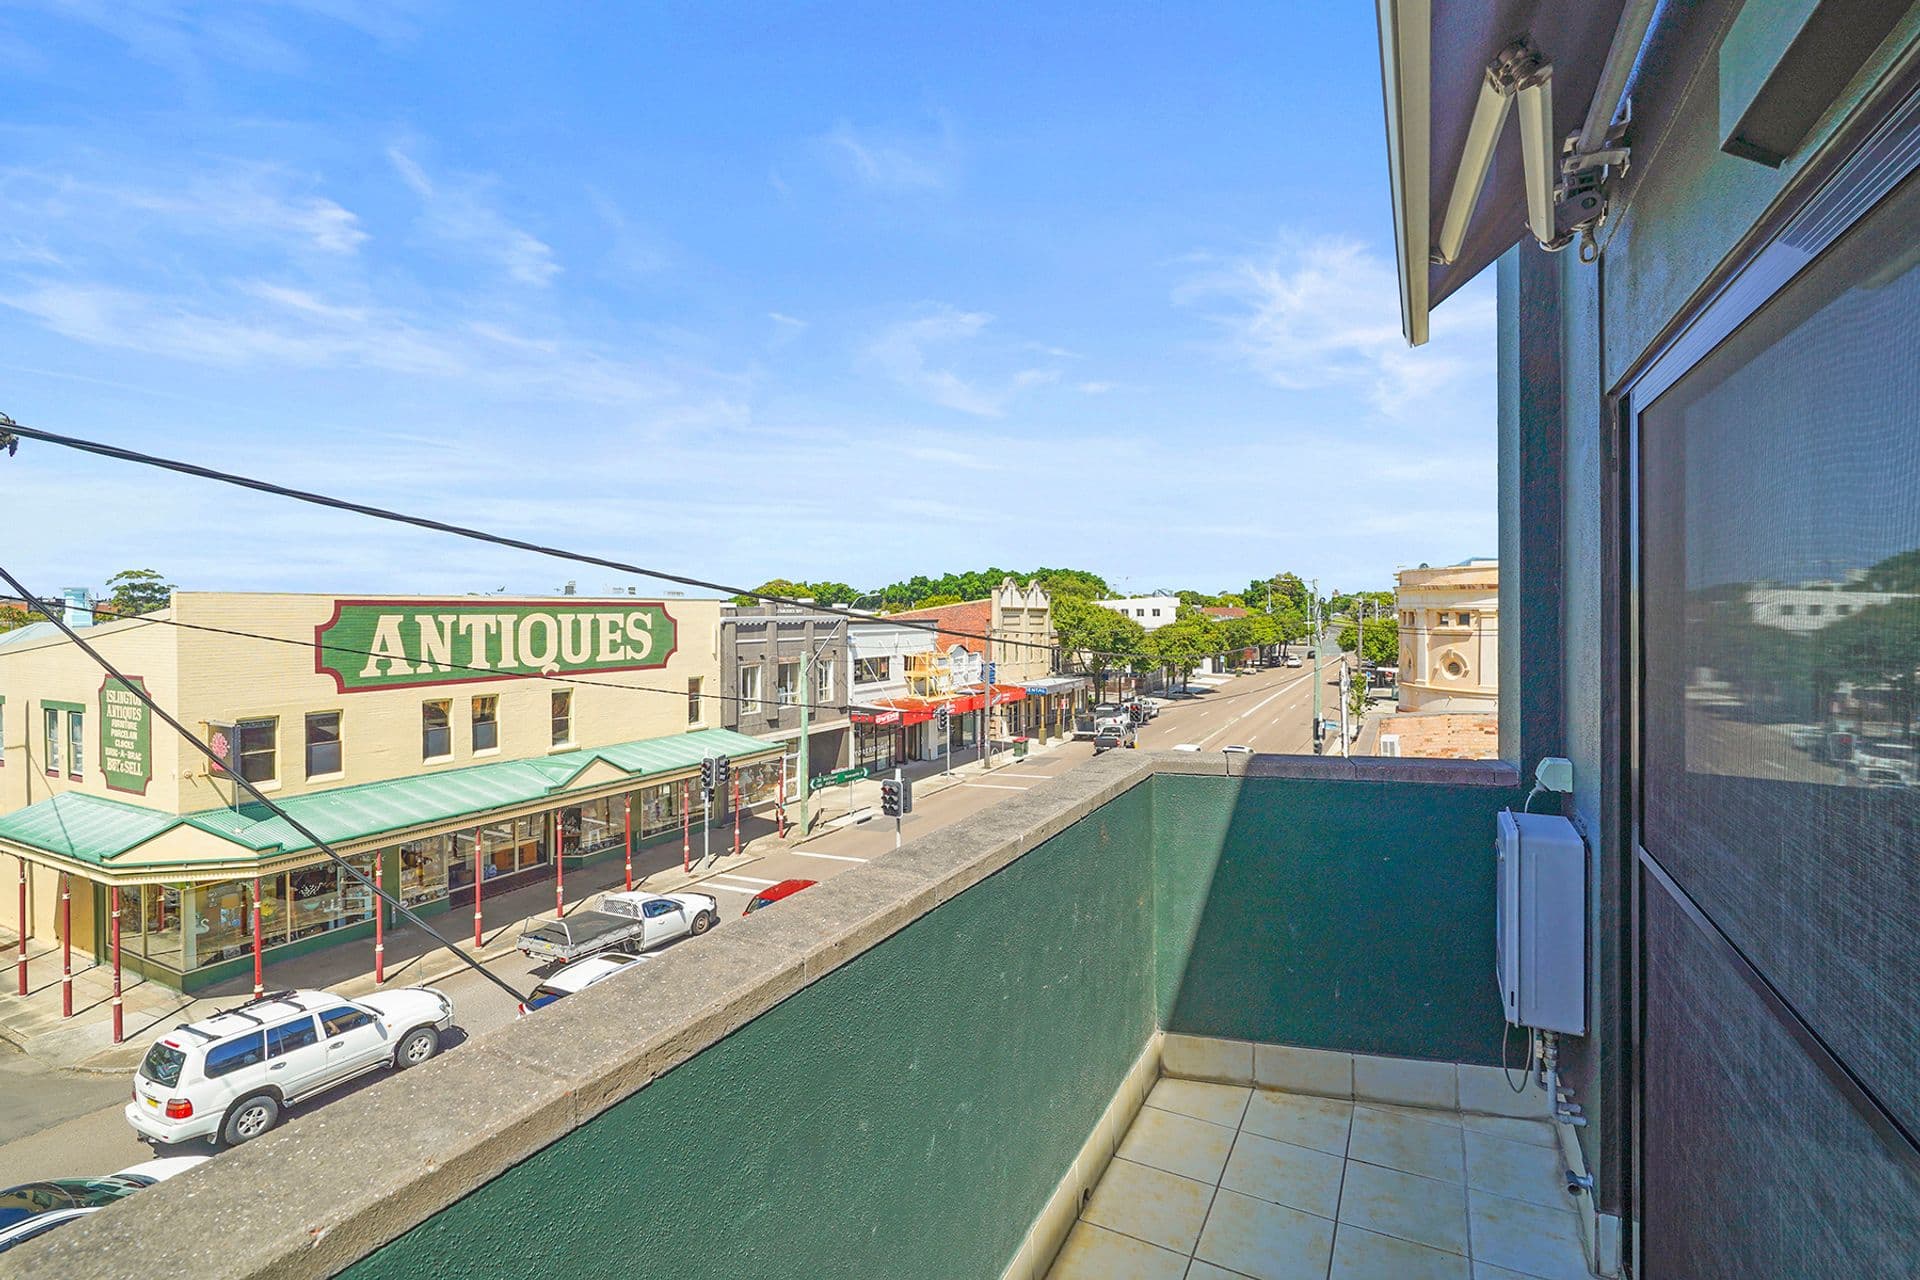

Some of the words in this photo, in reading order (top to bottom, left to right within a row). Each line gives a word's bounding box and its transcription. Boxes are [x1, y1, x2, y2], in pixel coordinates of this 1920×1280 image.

[359, 612, 653, 677] ANTIQUES
[106, 704, 142, 721] ANTIQUES
[115, 739, 134, 750] CLOCKS
[124, 763, 143, 776] SELL
